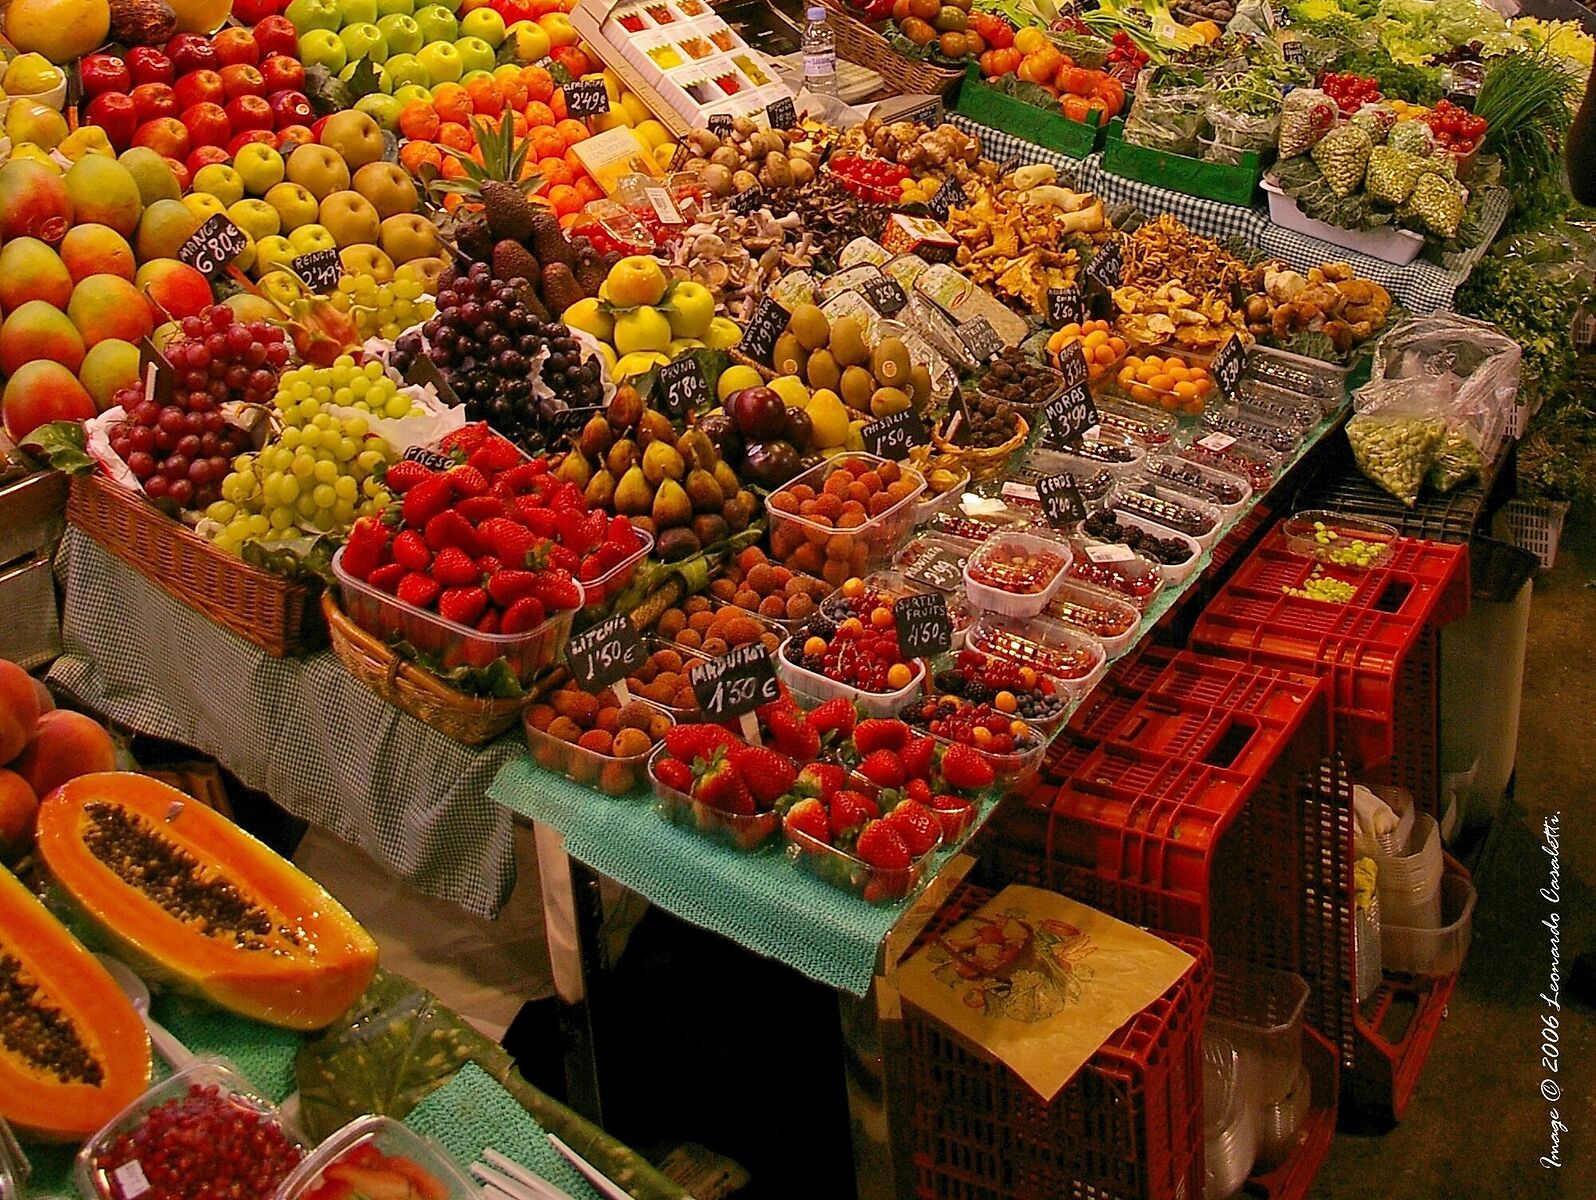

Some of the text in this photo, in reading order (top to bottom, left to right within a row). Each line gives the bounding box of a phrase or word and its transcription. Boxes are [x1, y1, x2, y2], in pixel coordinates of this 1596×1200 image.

[180, 219, 218, 262] MANGO
[660, 359, 696, 382] PRUNA
[1046, 387, 1085, 420] MORAS
[863, 411, 910, 437] PHISALIS
[1041, 474, 1071, 494] GERDS
[906, 605, 945, 621] FRUITS
